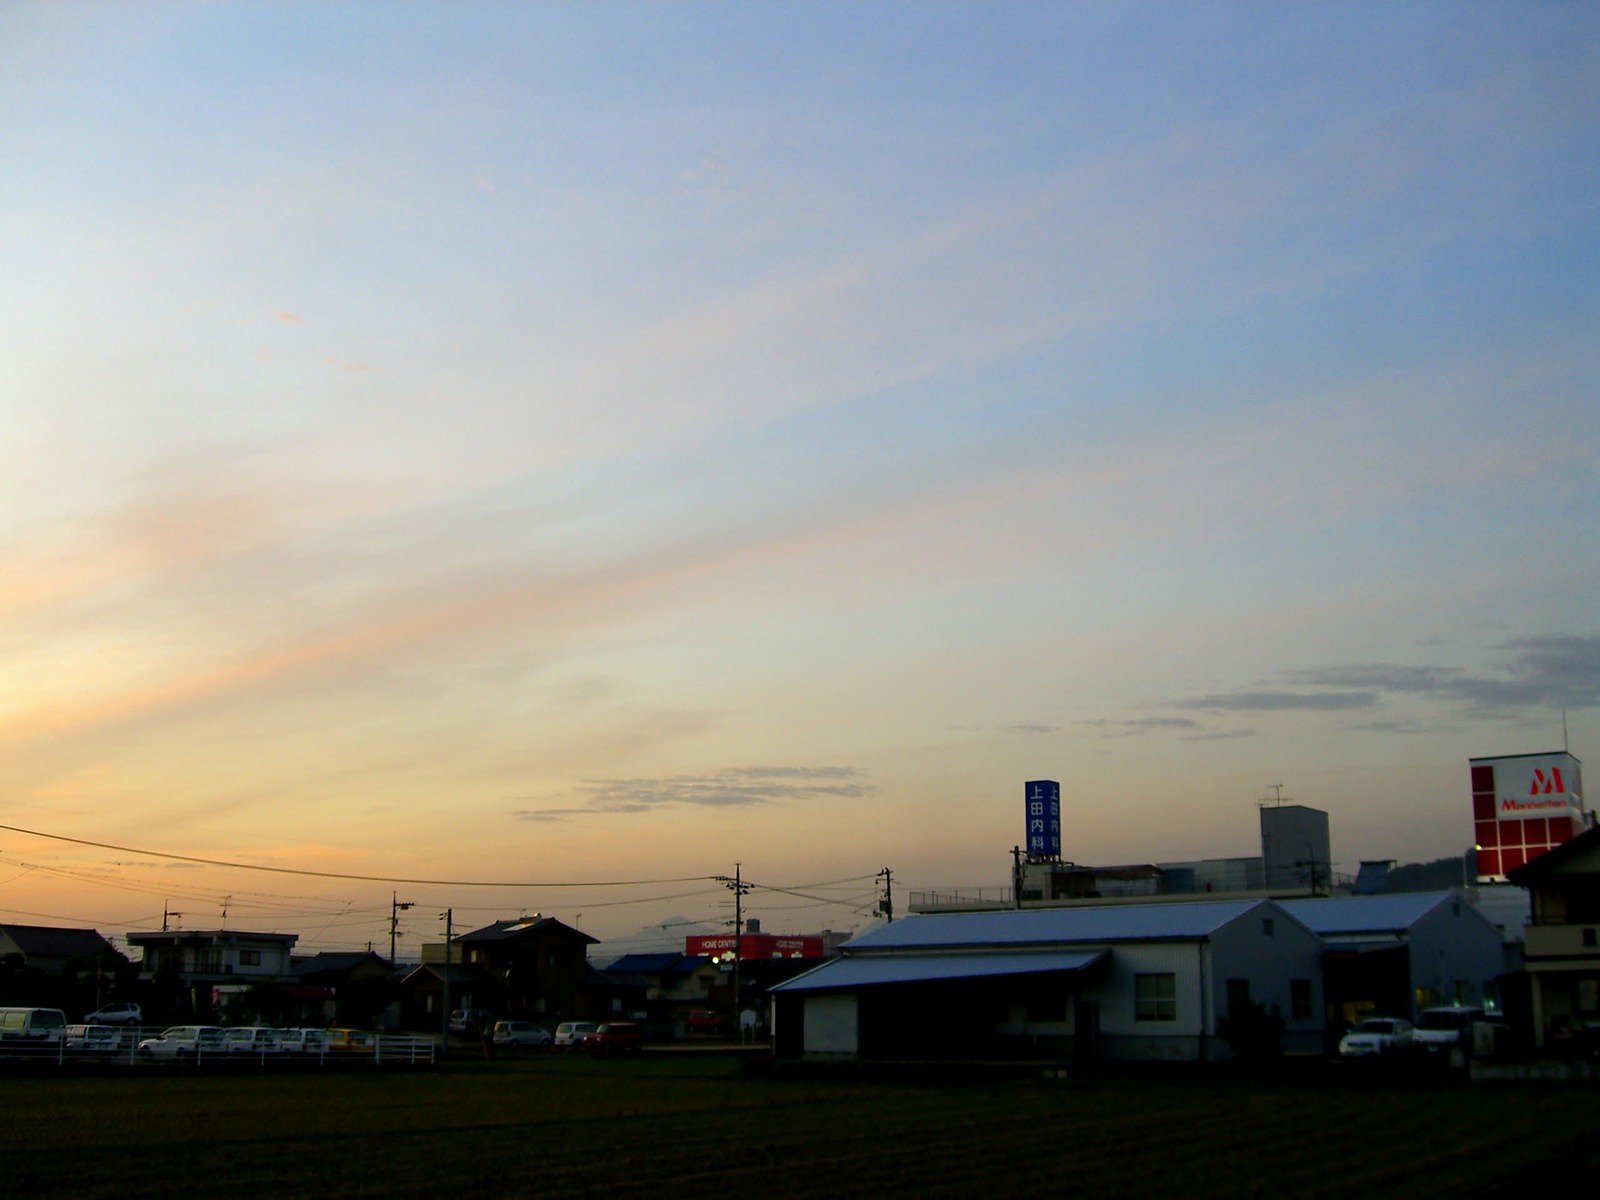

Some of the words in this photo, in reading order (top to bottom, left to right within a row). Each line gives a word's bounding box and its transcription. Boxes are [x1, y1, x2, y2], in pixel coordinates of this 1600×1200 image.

[1030, 785, 1044, 849] 上田内科
[701, 940, 717, 949] HOME
[717, 940, 737, 949] CENTE
